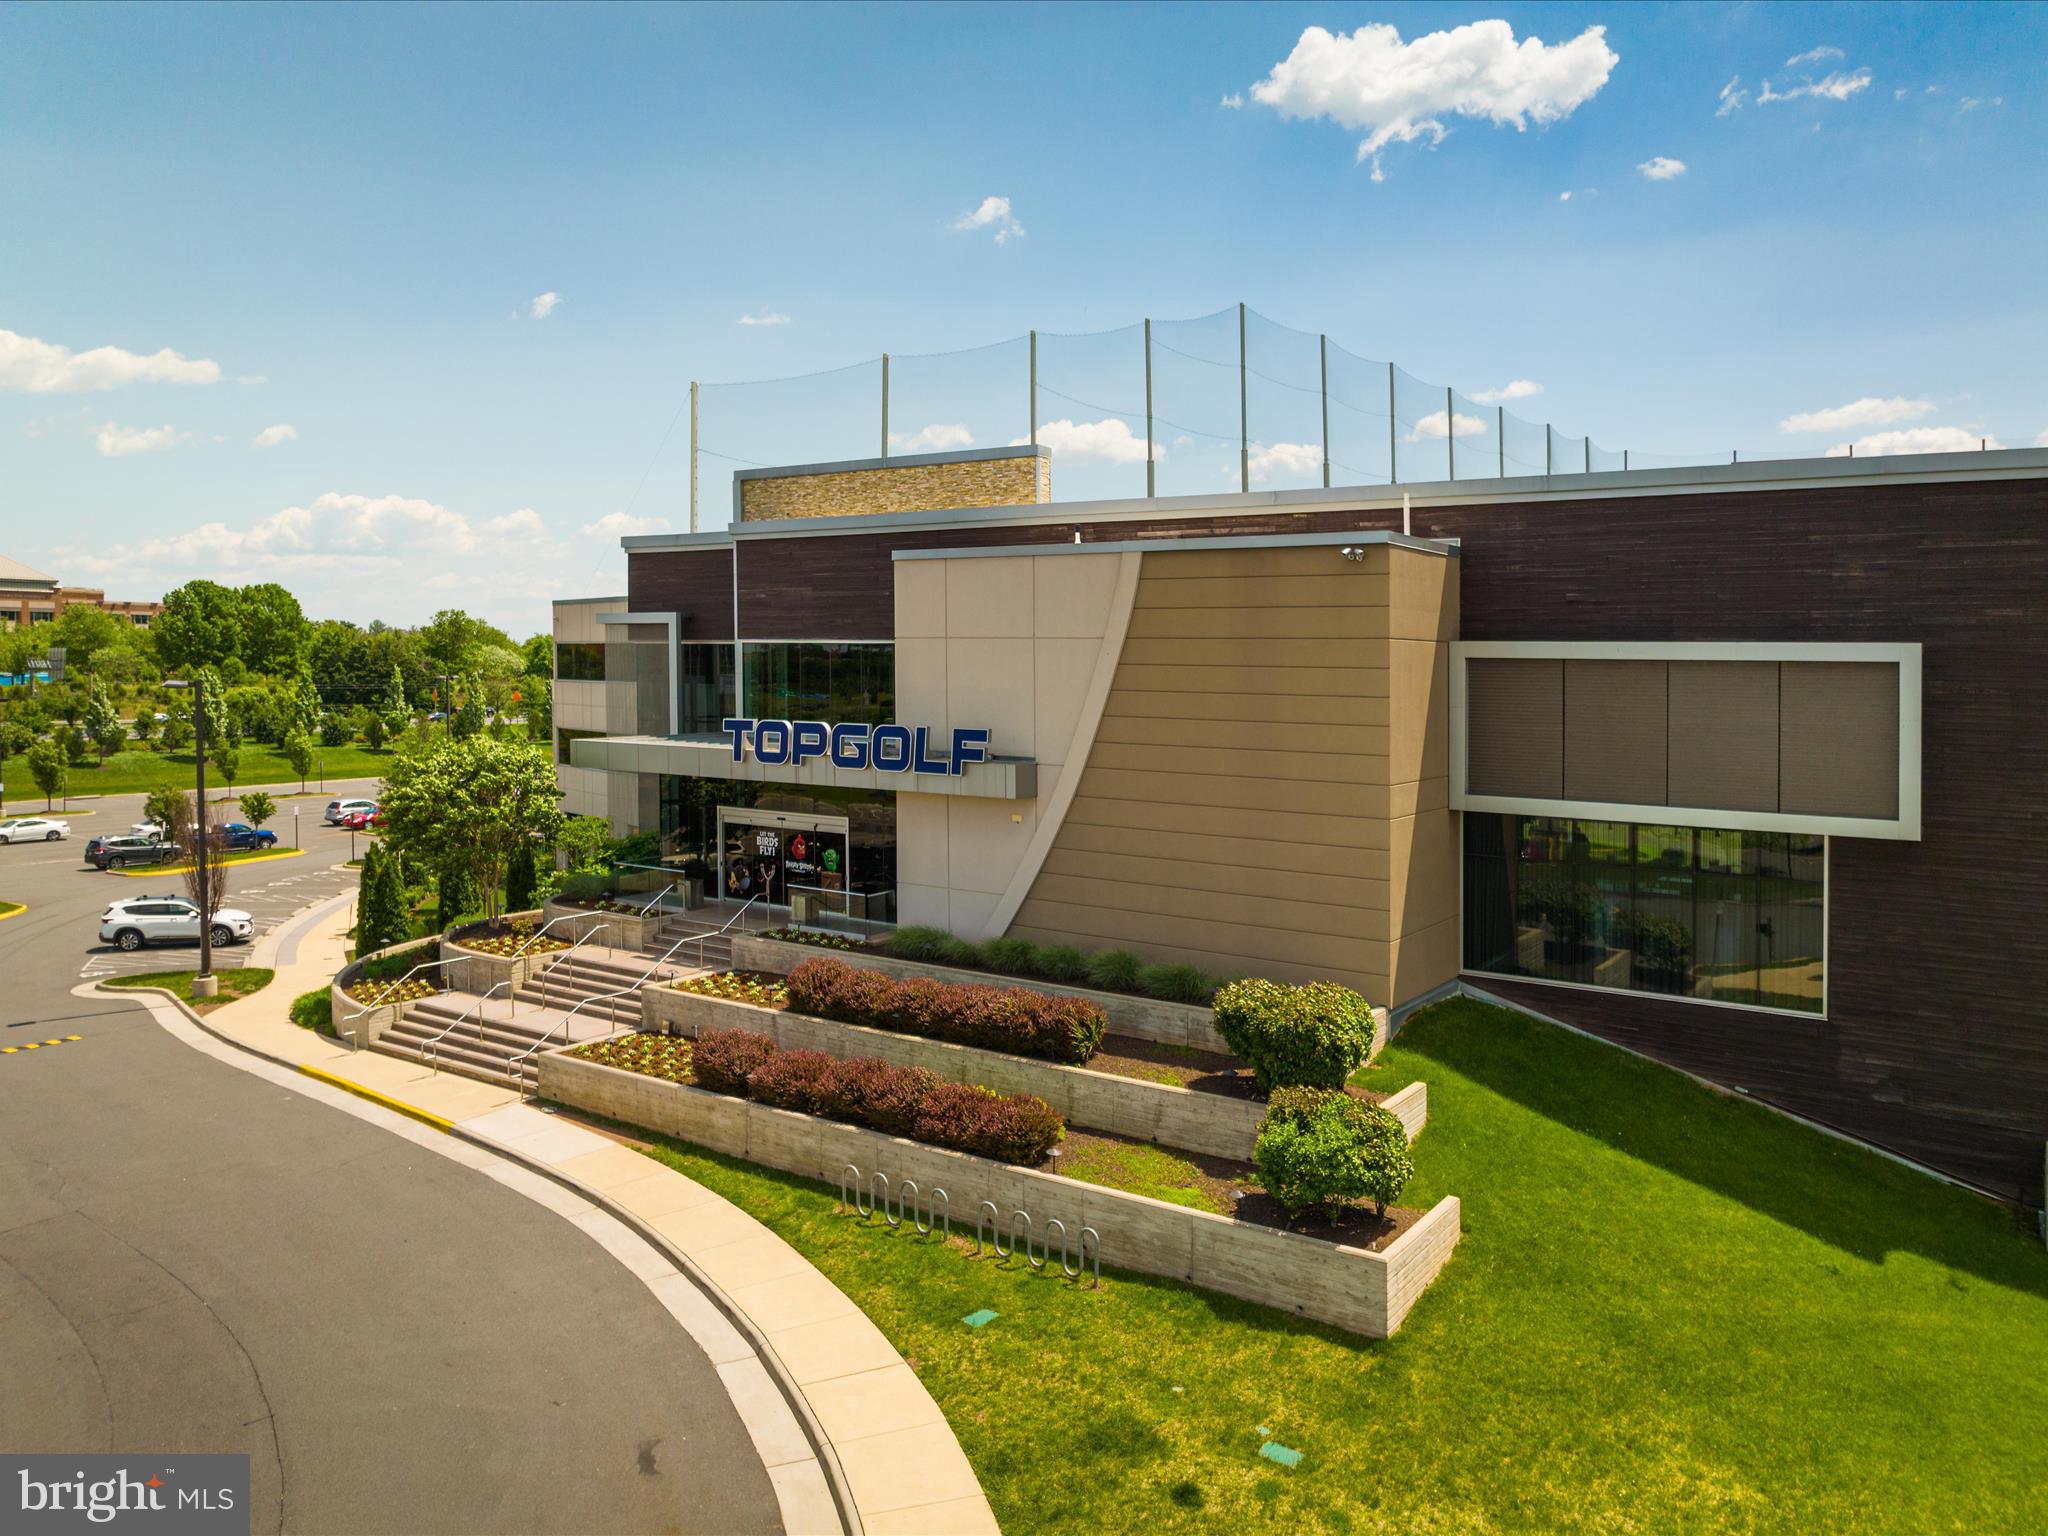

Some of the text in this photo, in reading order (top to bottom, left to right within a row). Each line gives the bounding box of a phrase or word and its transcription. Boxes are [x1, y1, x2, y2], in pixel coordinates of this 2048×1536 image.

[723, 718, 992, 776] TOPGOLF
[756, 836, 779, 847] BIRDS
[759, 846, 775, 856] FLY!
